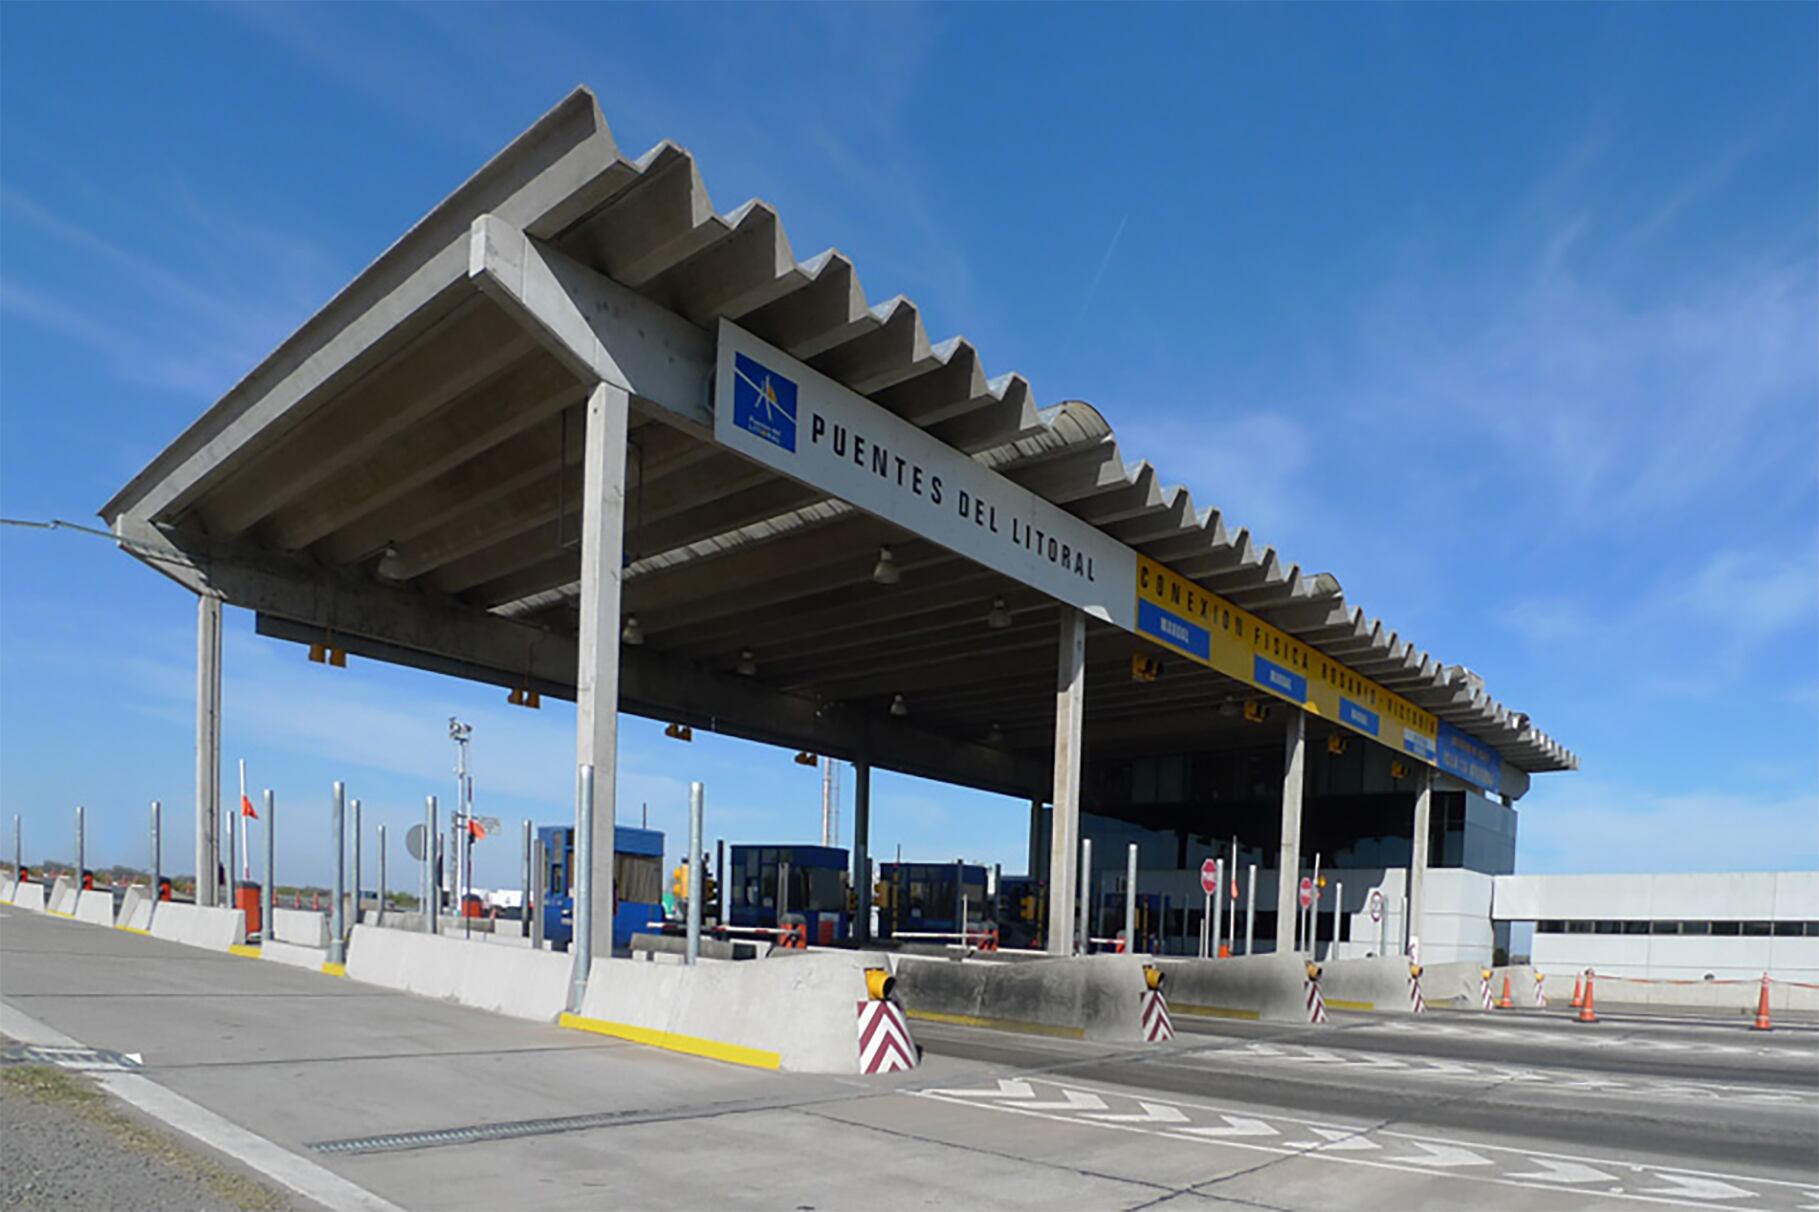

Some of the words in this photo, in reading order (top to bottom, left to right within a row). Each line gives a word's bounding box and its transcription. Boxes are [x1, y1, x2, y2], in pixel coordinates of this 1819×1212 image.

[812, 413, 943, 505] PUENTES
[958, 489, 998, 534] DEL
[1013, 517, 1095, 582] LITORAL
[1140, 565, 1243, 637] CONEXION
[1254, 627, 1308, 669] FISICA
